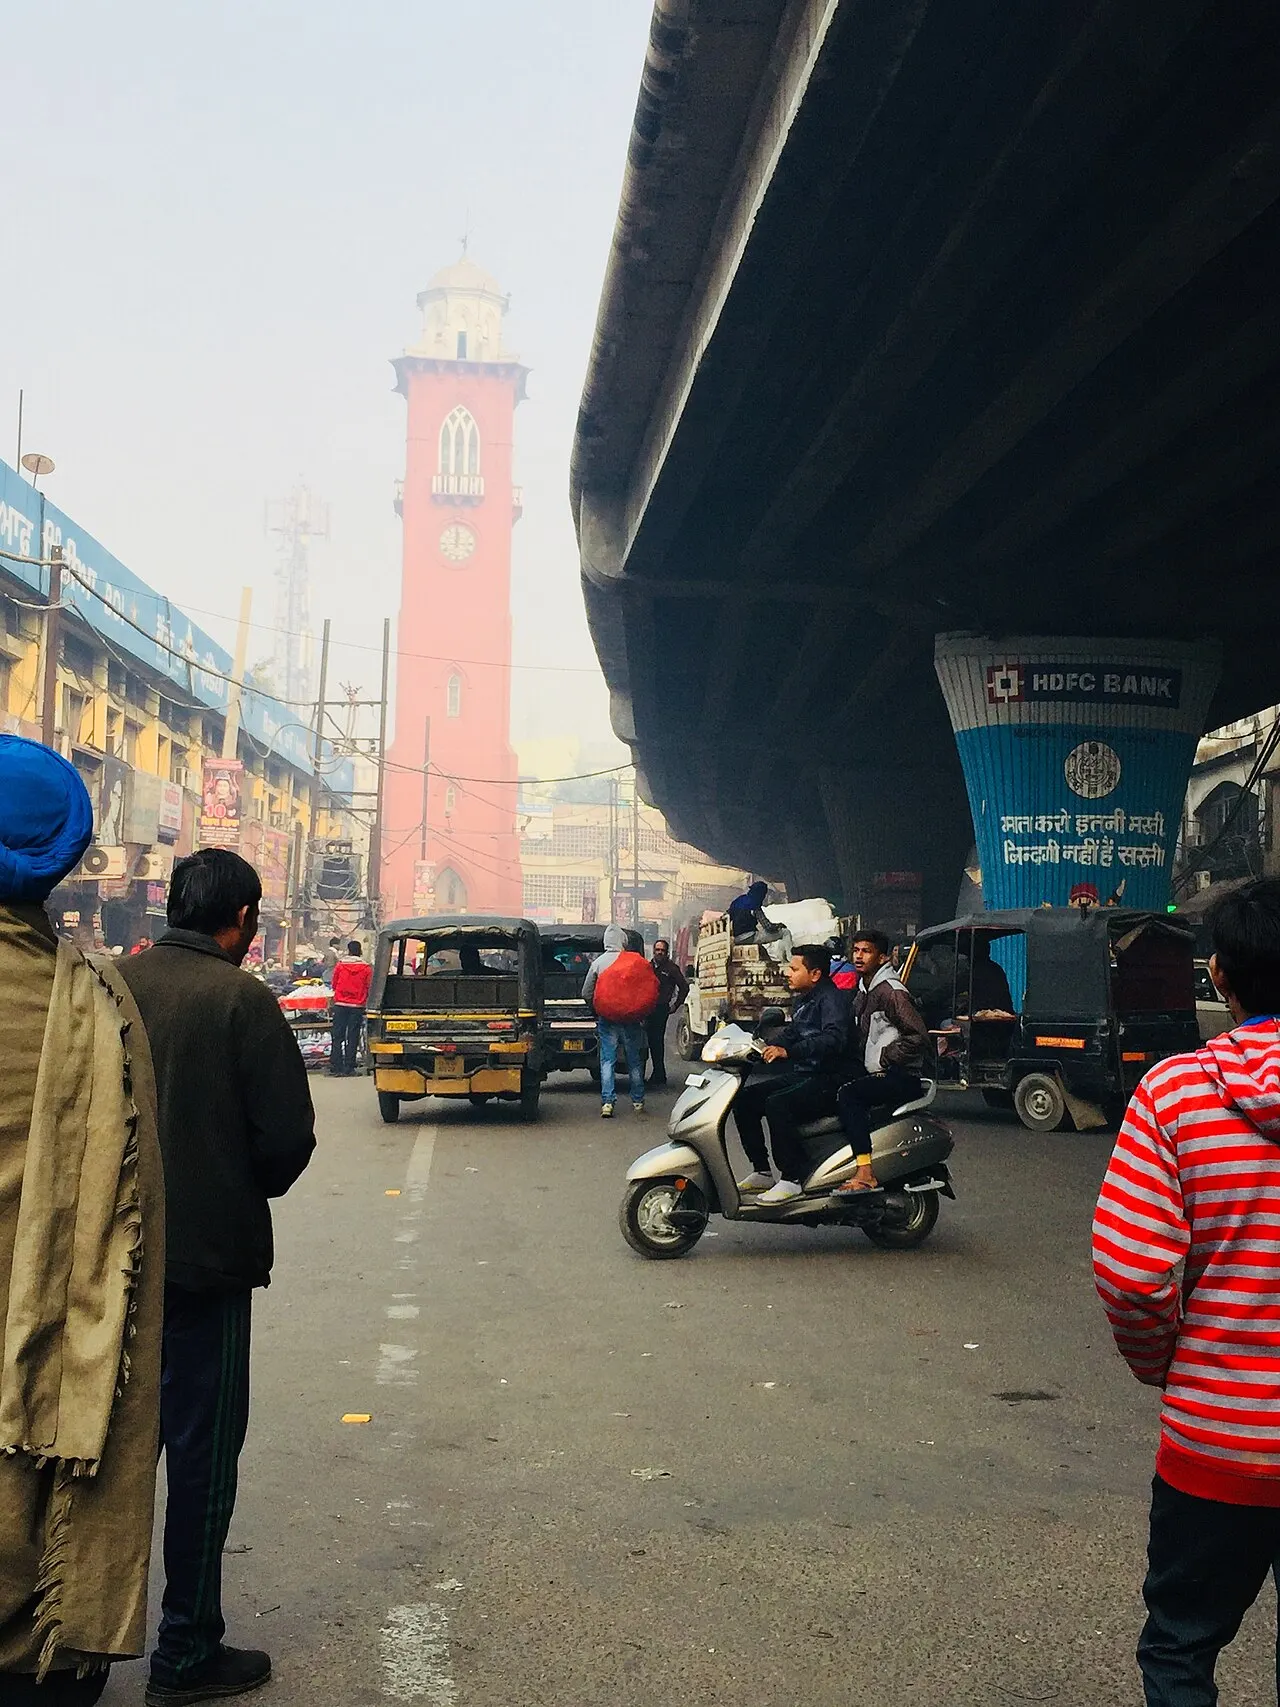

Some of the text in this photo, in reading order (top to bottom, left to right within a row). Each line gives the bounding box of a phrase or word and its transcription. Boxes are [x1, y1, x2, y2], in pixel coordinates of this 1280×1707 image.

[1032, 672, 1172, 699] HDFC BANK
[1035, 808, 1071, 834] करो
[1075, 808, 1126, 837] इतनी
[1004, 839, 1060, 866] जिन्दगी
[1062, 836, 1099, 865] नहीं
